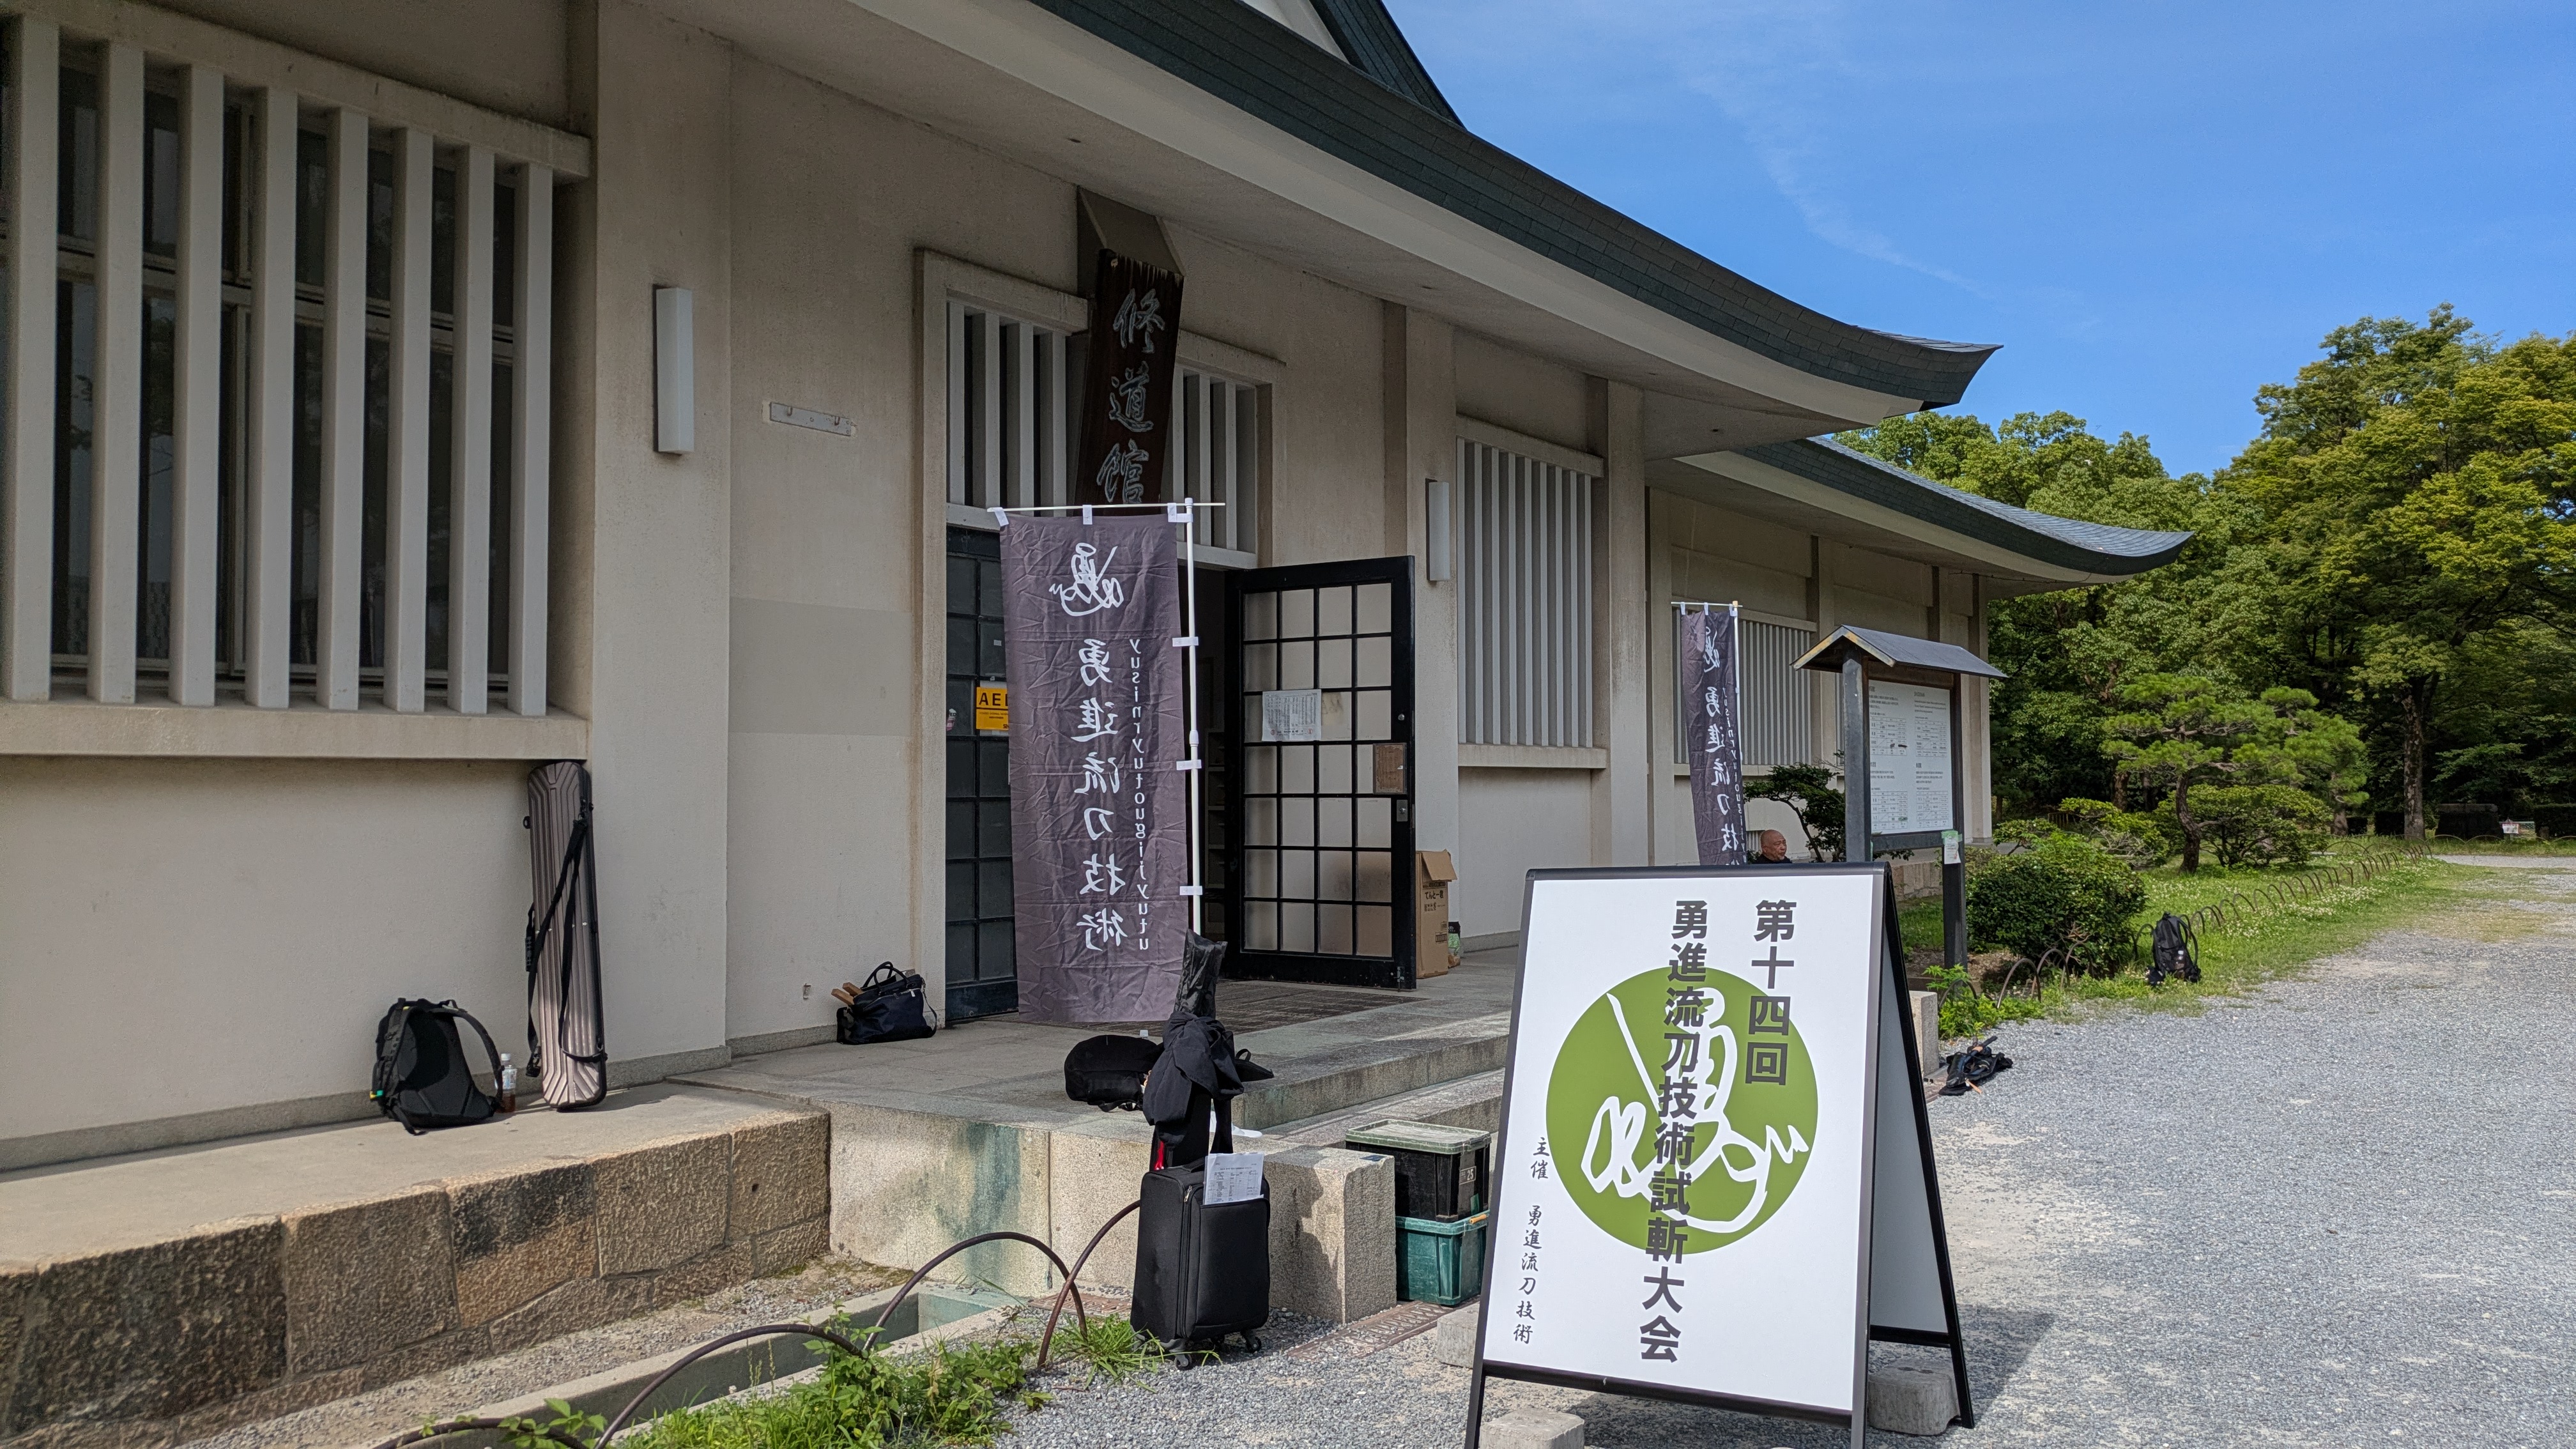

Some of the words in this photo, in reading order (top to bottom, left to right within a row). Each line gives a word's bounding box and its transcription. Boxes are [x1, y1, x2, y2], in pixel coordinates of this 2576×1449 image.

[1096, 288, 1165, 504] 修道館
[979, 693, 1008, 706] AE
[1744, 899, 1797, 1086] 第十四回
[1467, 1169, 1474, 1181] 25
[1531, 1137, 1550, 1179] 主催
[1639, 900, 1708, 1363] 勇進流刀技術試斬大会
[1513, 1205, 1542, 1344] 勇進流刀技術
